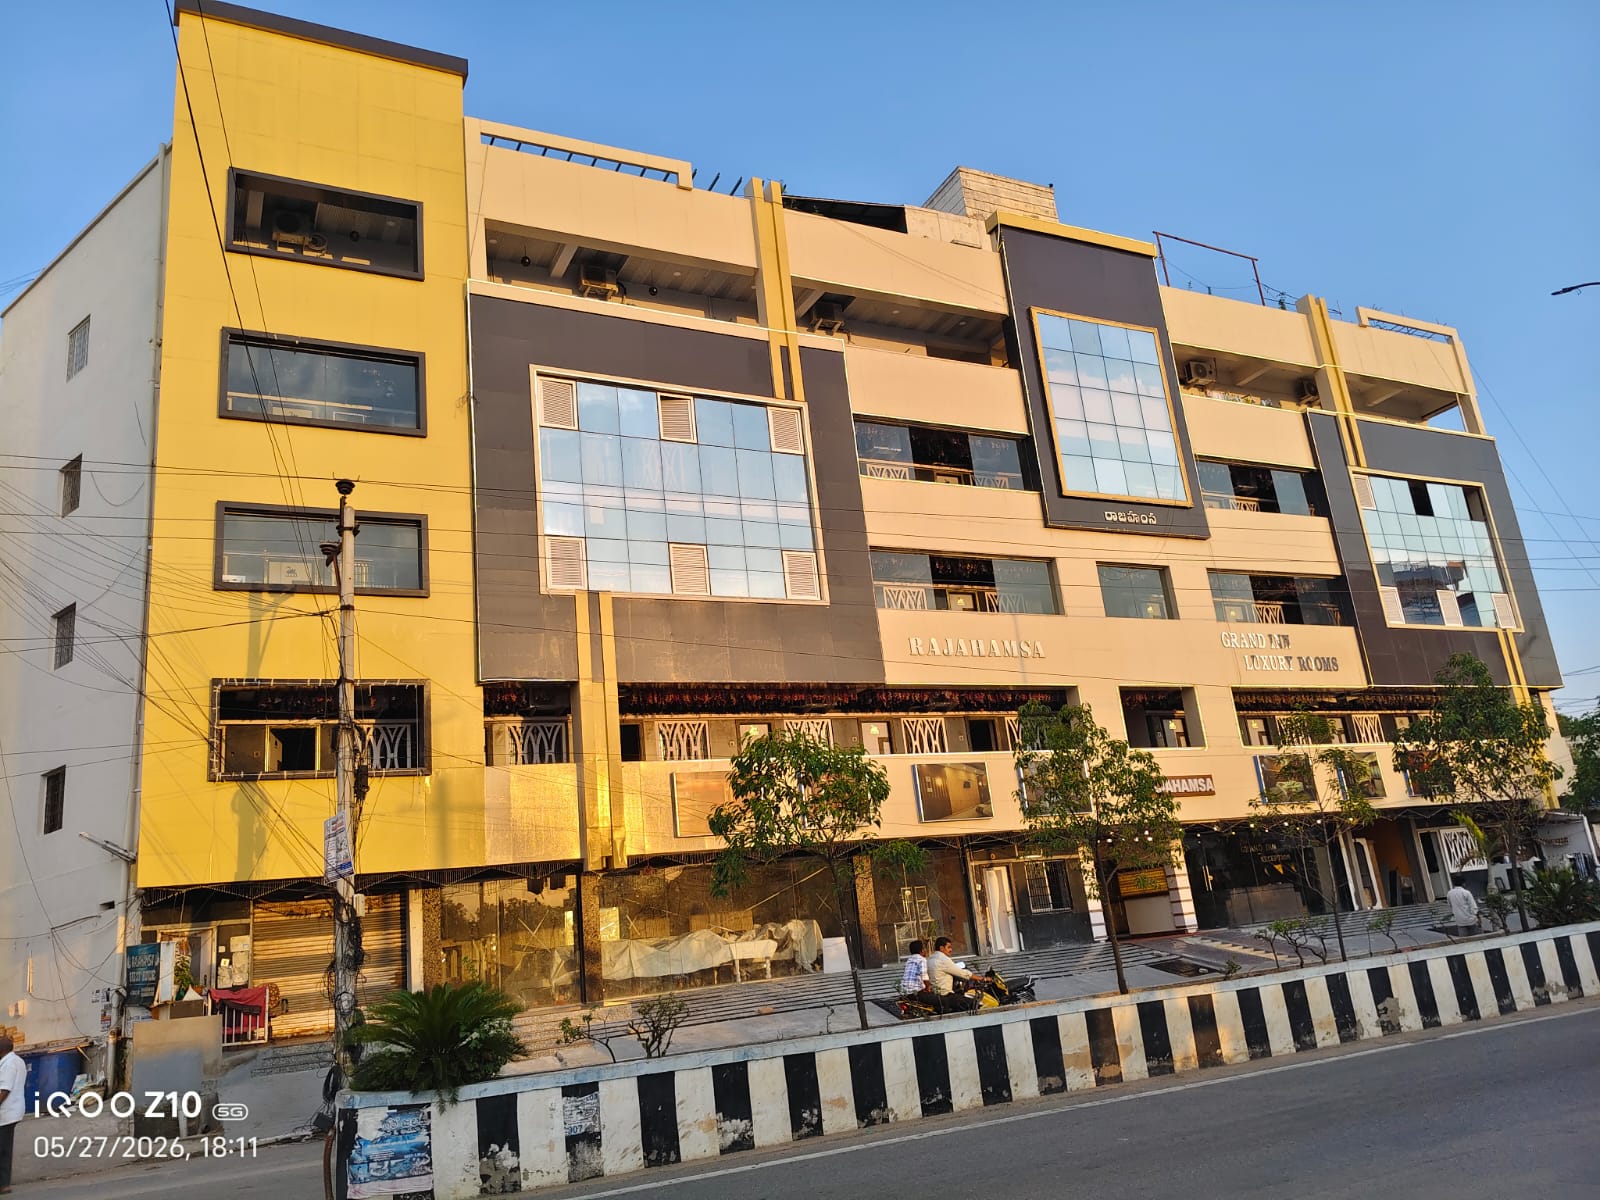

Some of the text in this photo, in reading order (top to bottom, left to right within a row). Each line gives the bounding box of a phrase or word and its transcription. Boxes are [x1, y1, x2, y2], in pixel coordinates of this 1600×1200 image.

[1104, 510, 1157, 525] రాజహంస
[907, 636, 1047, 659] RAJAHAMSA
[1220, 631, 1292, 649] GRAND INN
[1244, 654, 1339, 672] LUXURY ROOMS
[1154, 777, 1215, 794] JAHAMSA
